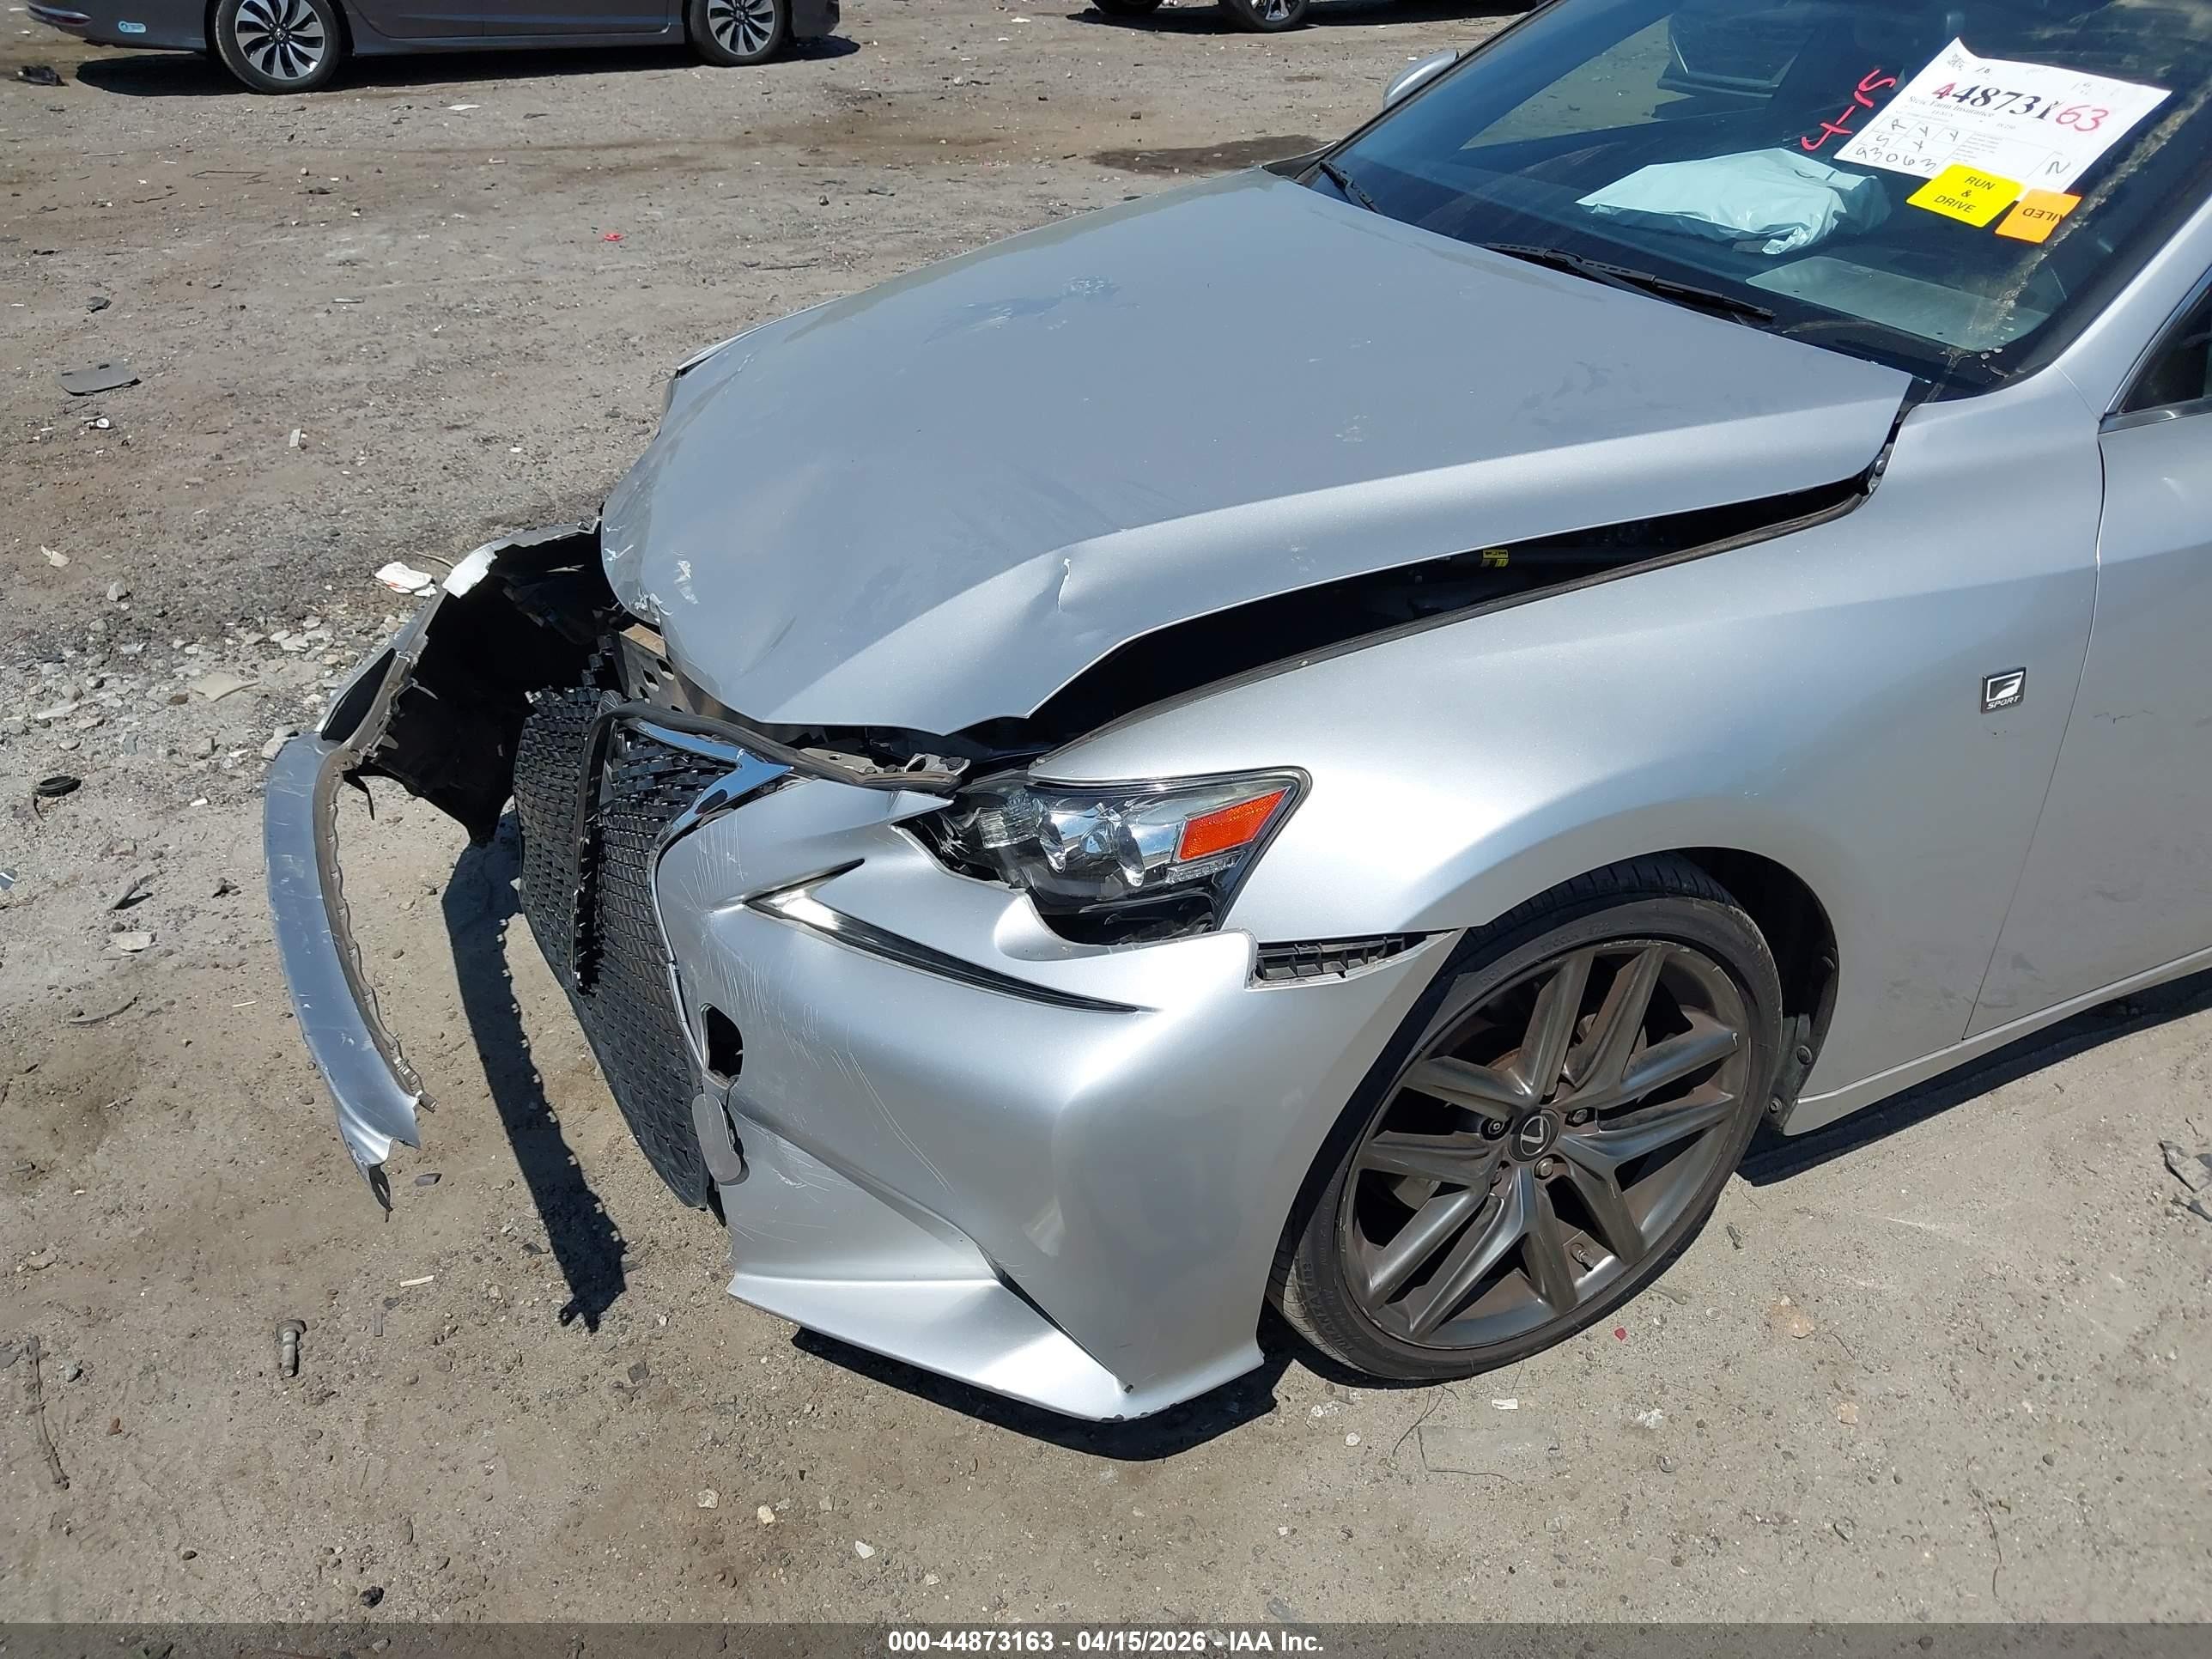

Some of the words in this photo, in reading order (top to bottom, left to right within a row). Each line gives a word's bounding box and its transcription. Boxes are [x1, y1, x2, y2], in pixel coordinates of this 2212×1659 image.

[1929, 100, 1952, 110] Farm
[1953, 105, 1995, 118] Insurance
[1964, 175, 1996, 191] RUN
[1960, 190, 1972, 198] &
[1933, 194, 1977, 214] DRIVE
[1986, 695, 2021, 710] SPORT
